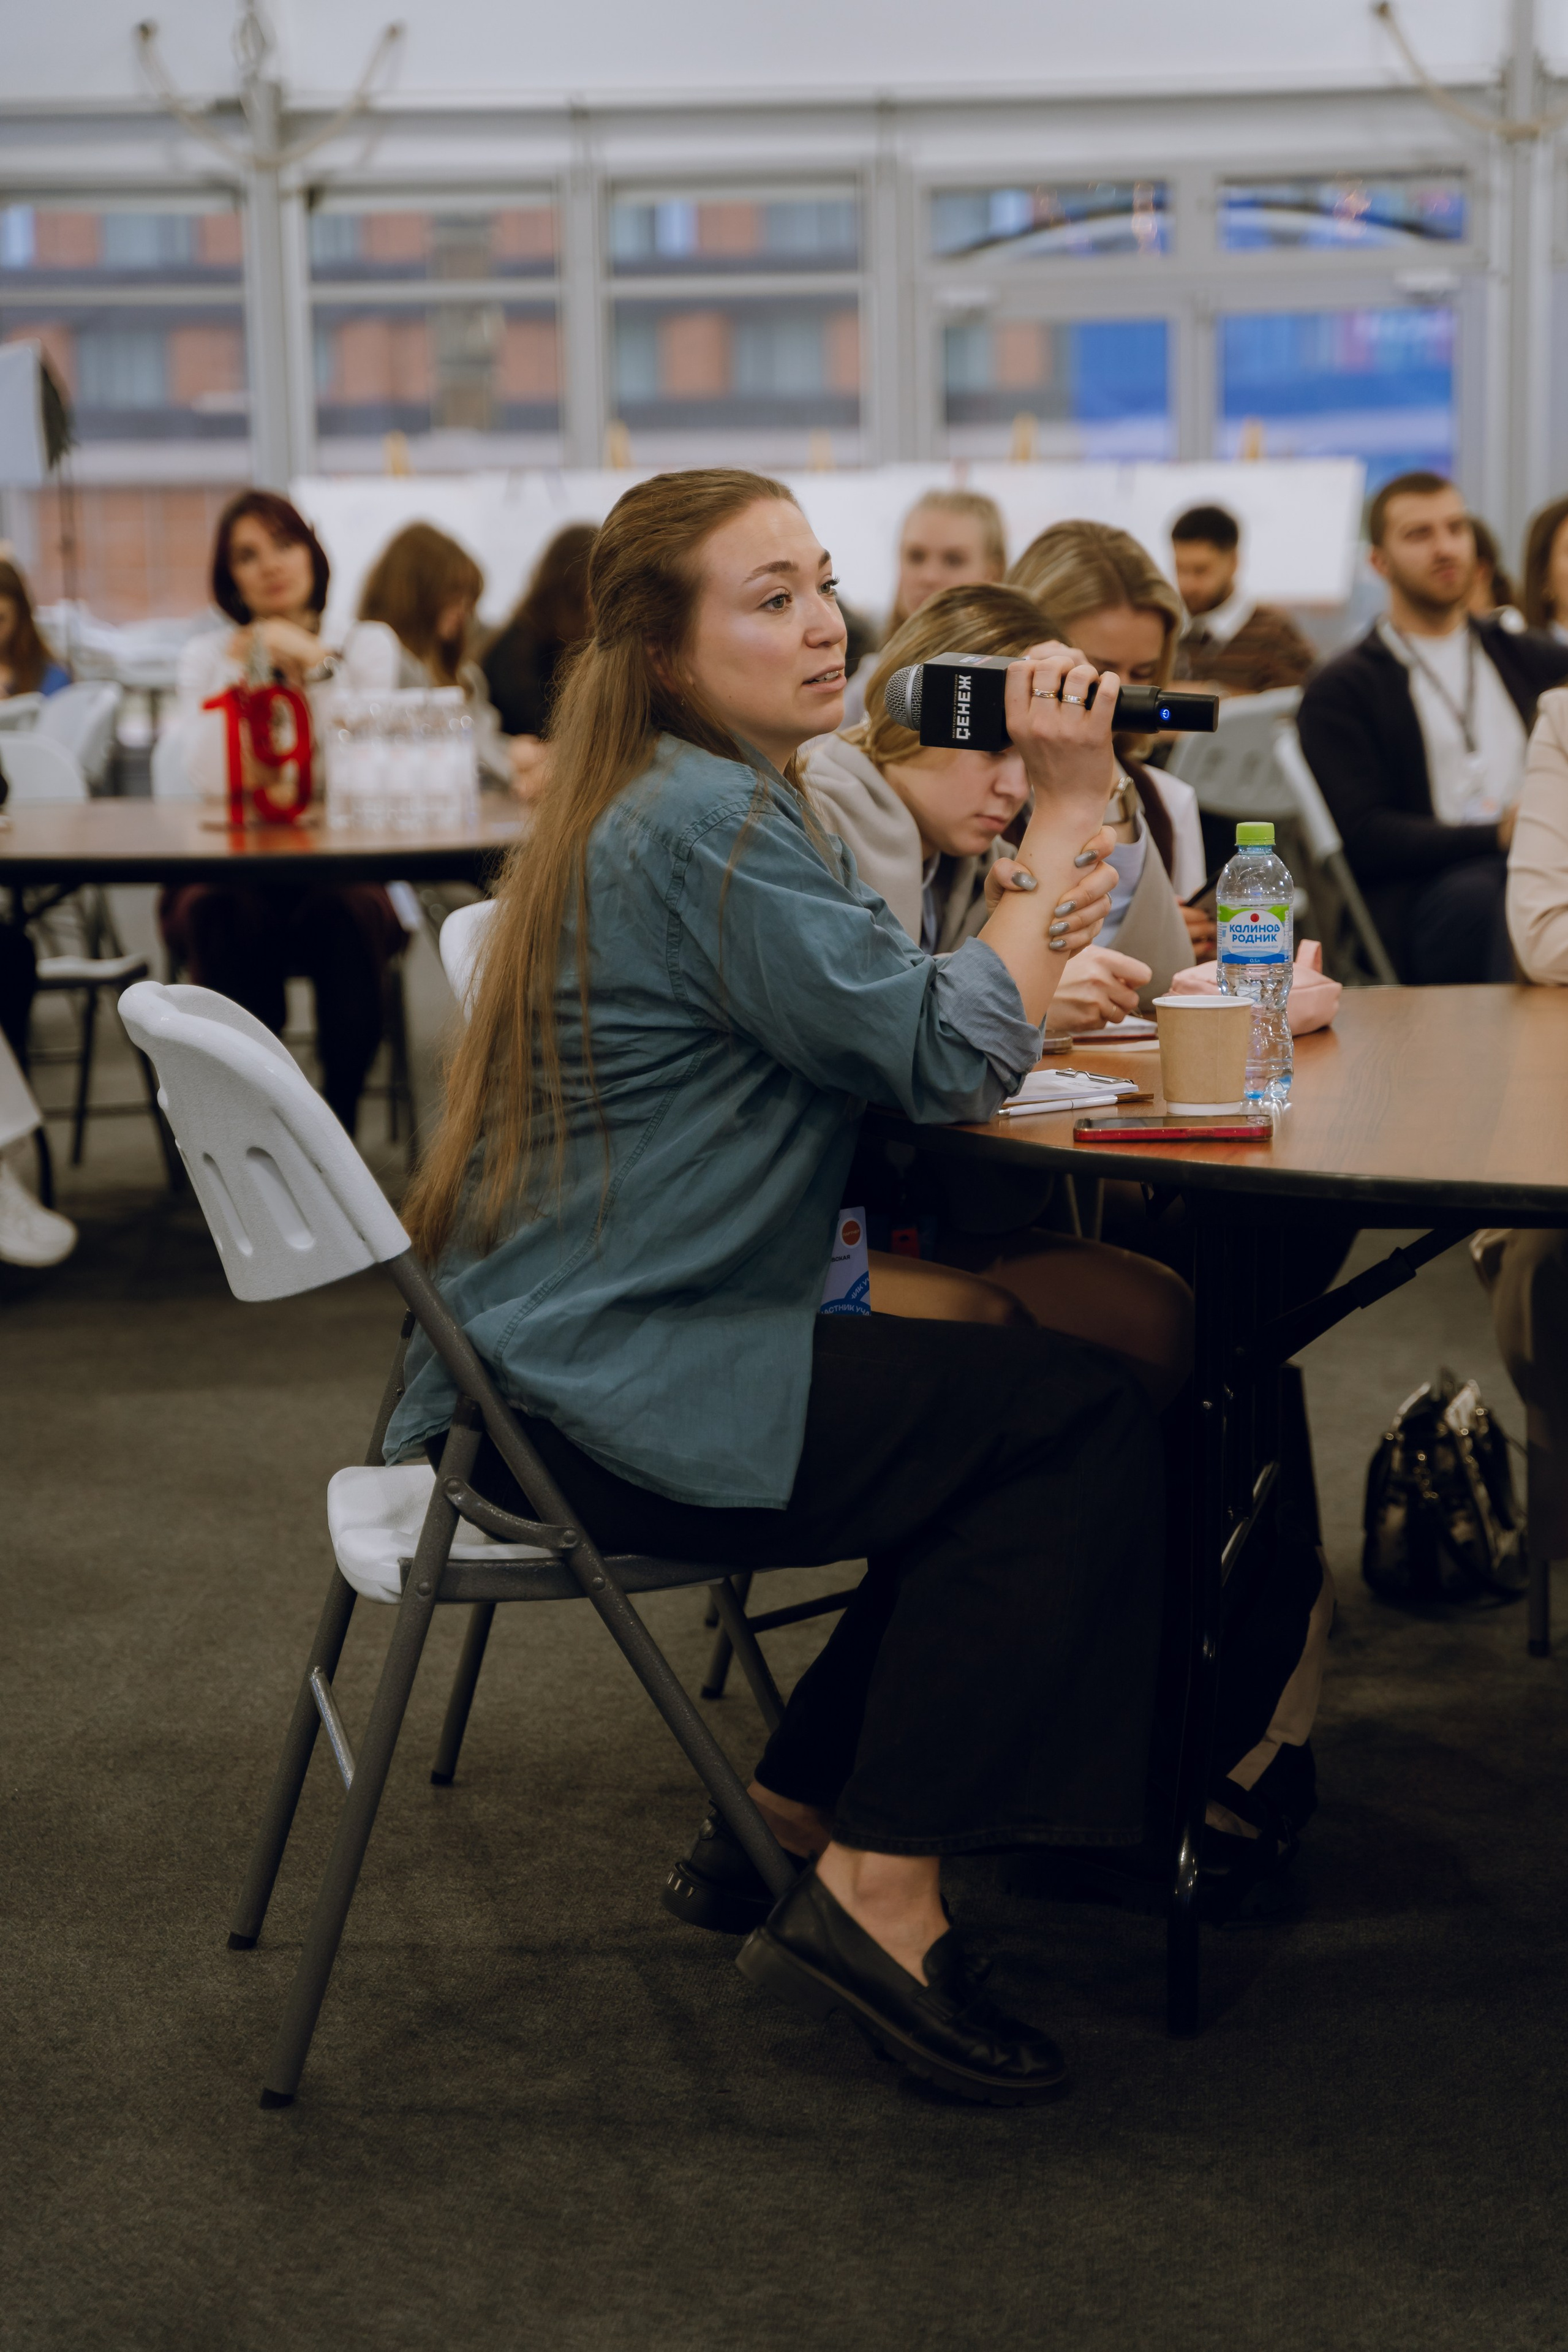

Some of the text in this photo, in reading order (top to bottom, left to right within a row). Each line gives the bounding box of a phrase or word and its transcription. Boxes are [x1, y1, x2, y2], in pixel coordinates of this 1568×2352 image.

[956, 674, 971, 740] СЕНЕЖ
[203, 684, 312, 824] 19
[1232, 934, 1277, 943] РОДНИК
[821, 1304, 855, 1314] АСТНИК
